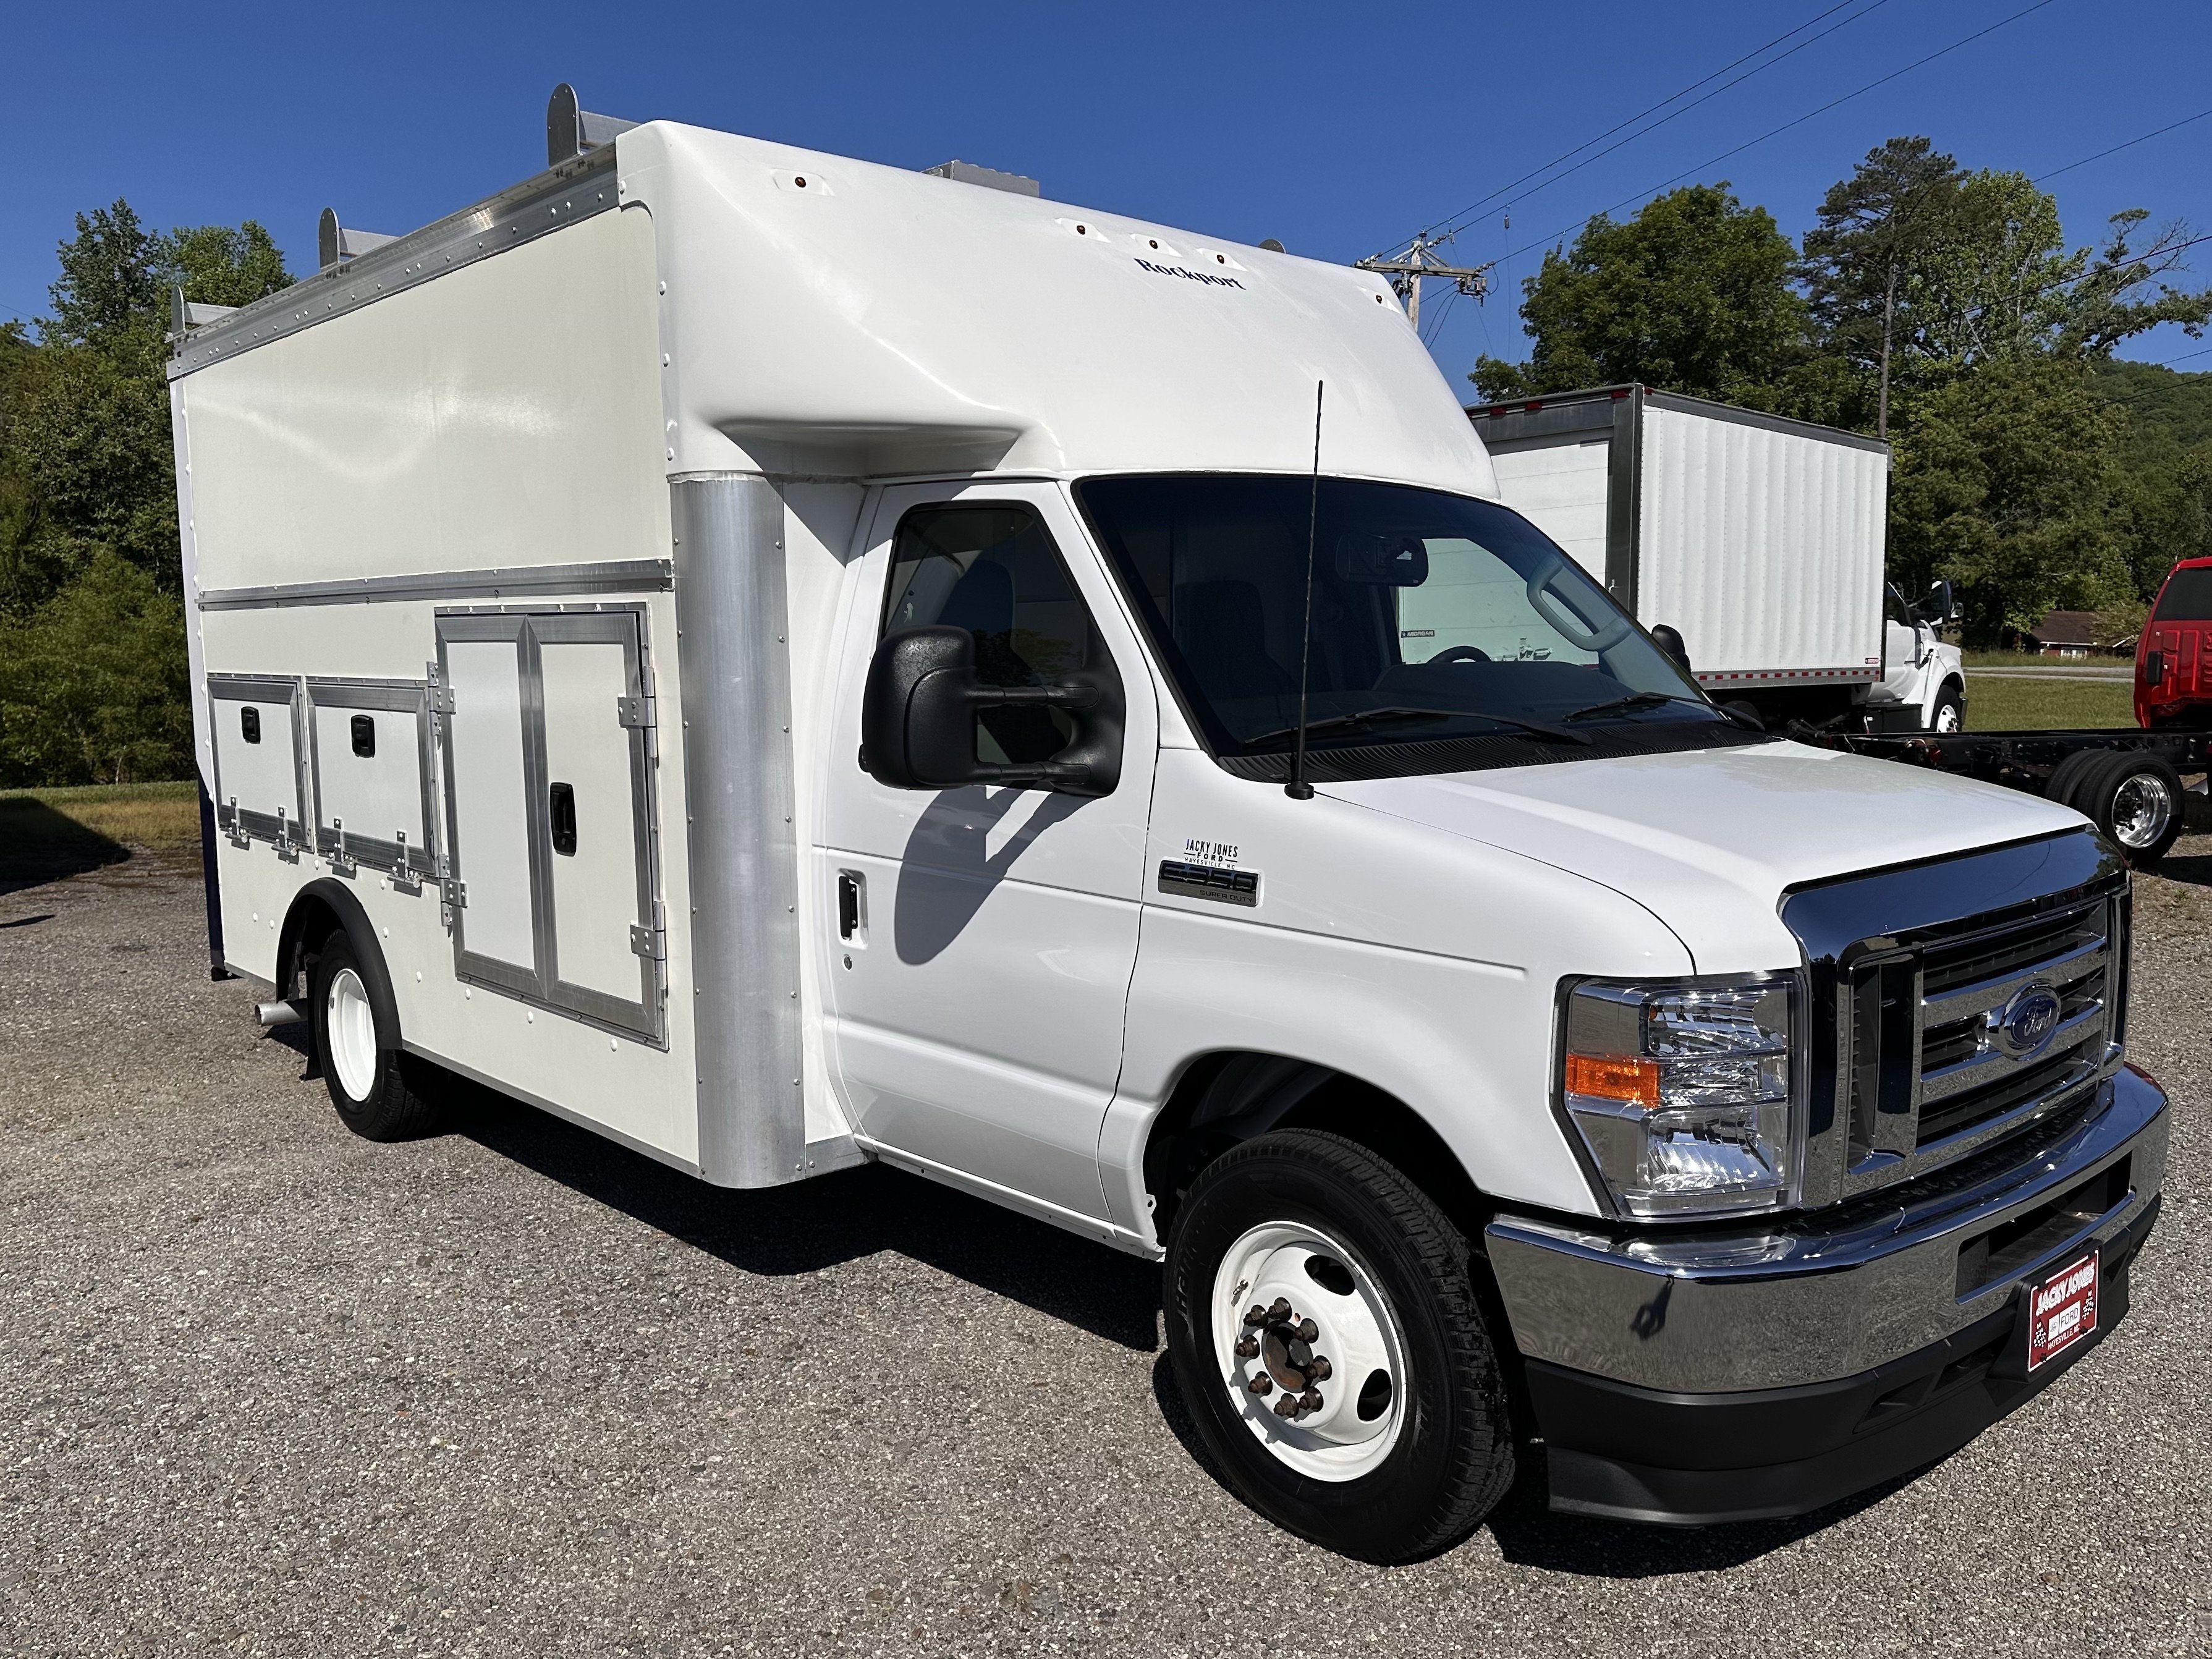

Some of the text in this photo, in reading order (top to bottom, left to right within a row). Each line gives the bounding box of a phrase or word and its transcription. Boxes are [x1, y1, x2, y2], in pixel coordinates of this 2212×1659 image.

[1134, 258, 1246, 290] Rockport
[1186, 839, 1239, 858] JACKY JONES
[1197, 852, 1223, 862] FORD
[1184, 857, 1221, 868] HAYESVILLE
[1200, 889, 1252, 902] SUPER DUTY
[2035, 1262, 2095, 1317] JACKY JONES
[2061, 1308, 2079, 1328] FORD
